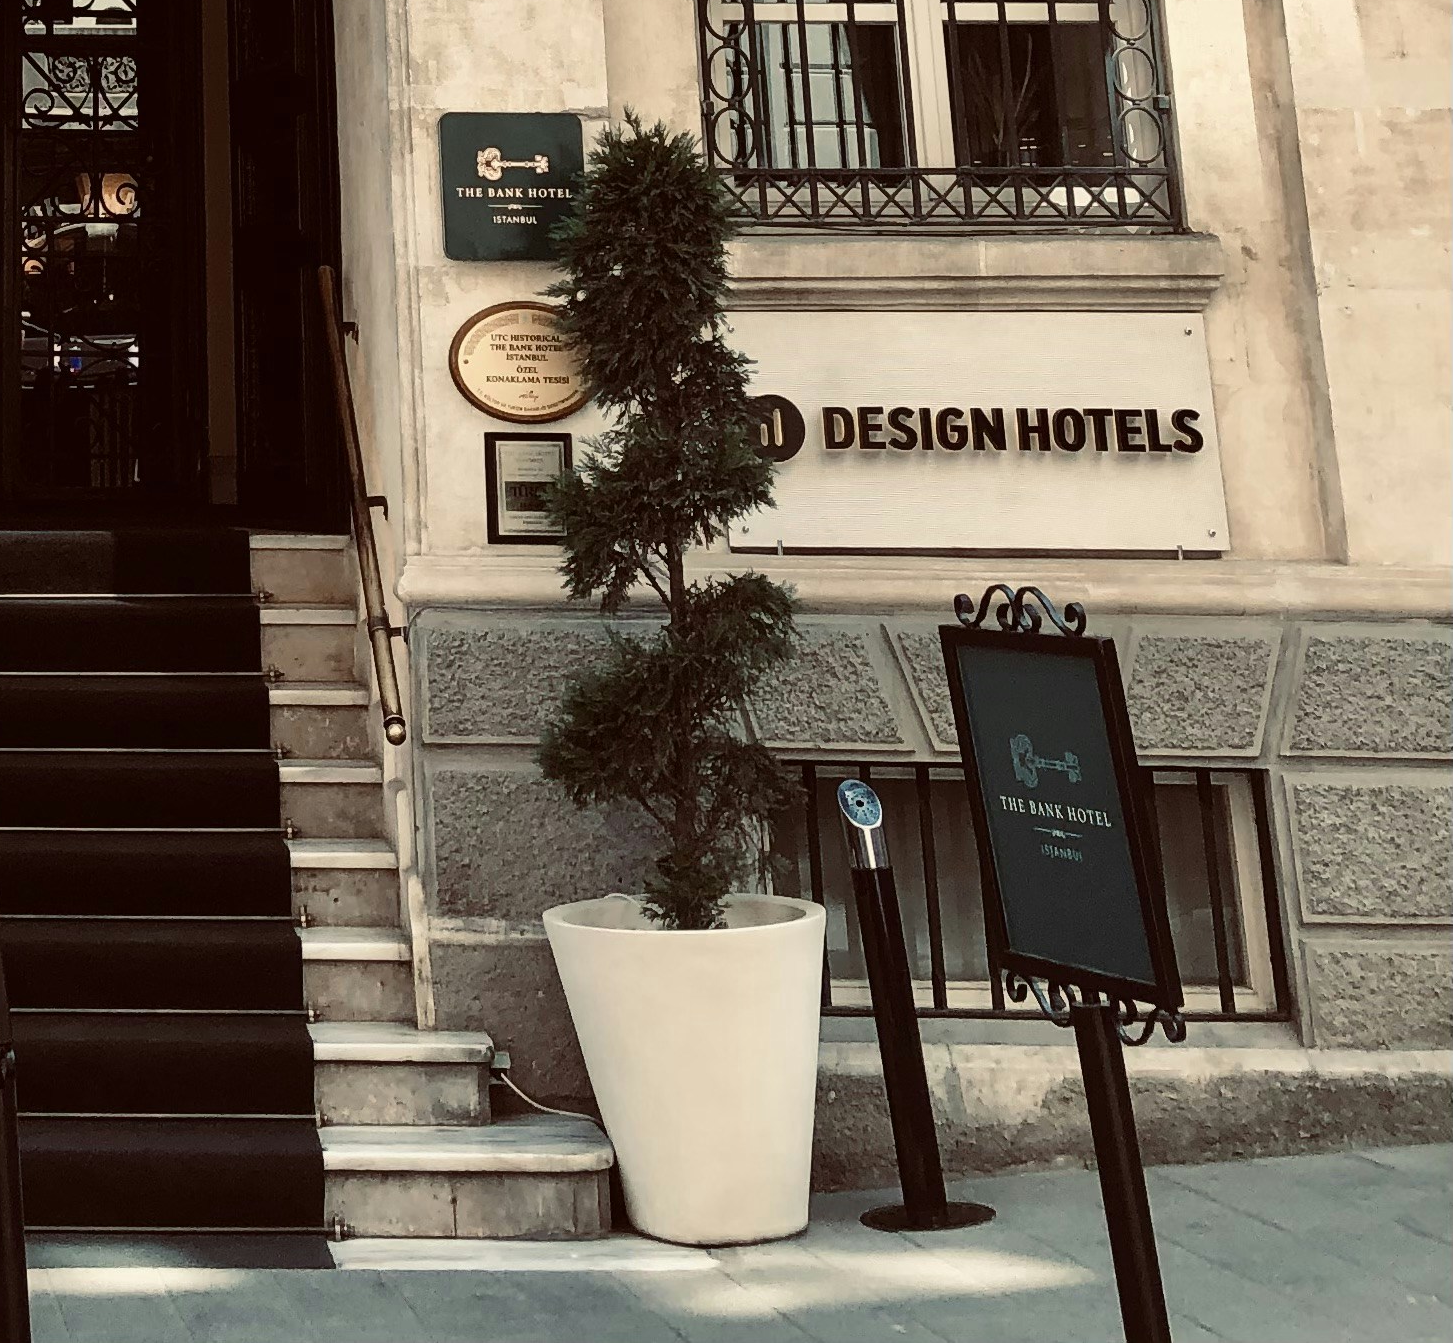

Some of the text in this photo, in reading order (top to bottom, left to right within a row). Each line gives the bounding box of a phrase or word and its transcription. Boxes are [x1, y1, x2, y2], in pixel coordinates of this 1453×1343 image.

[456, 187, 573, 198] THE BANK HOTEL
[493, 215, 537, 224] ISTANBUL
[490, 334, 562, 343] UTC HISTORICAL
[490, 343, 563, 352] THE BANK HOTEL
[516, 364, 538, 374] ÖZEL
[486, 375, 541, 384] KONAKLAMA
[822, 405, 1204, 454] DESIGN HOTELS
[999, 795, 1112, 828] THE BANK HOTEL
